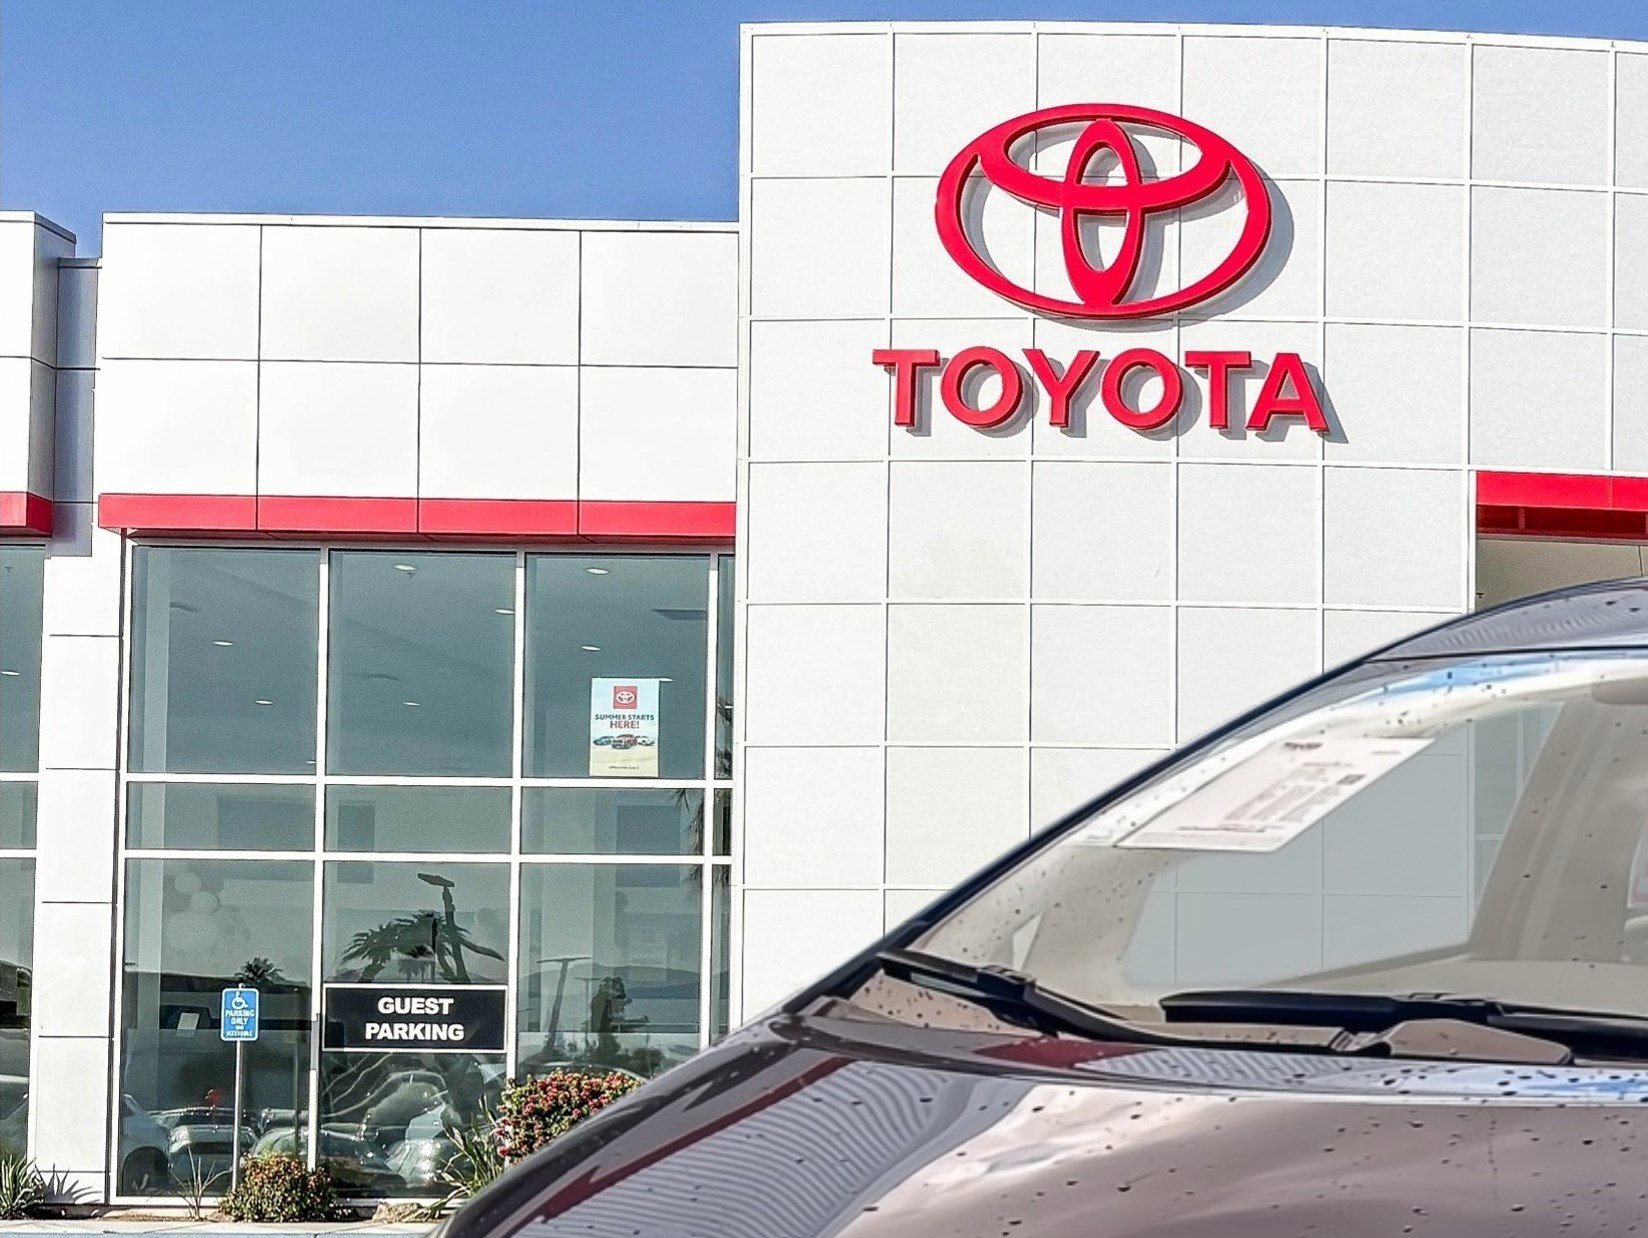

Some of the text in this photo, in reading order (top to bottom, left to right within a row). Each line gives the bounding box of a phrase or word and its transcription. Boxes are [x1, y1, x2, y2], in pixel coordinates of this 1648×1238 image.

[872, 346, 1330, 432] TOYOTA
[609, 720, 640, 729] HERE!
[377, 996, 455, 1016] GUEST
[365, 1022, 465, 1042] PARKING
